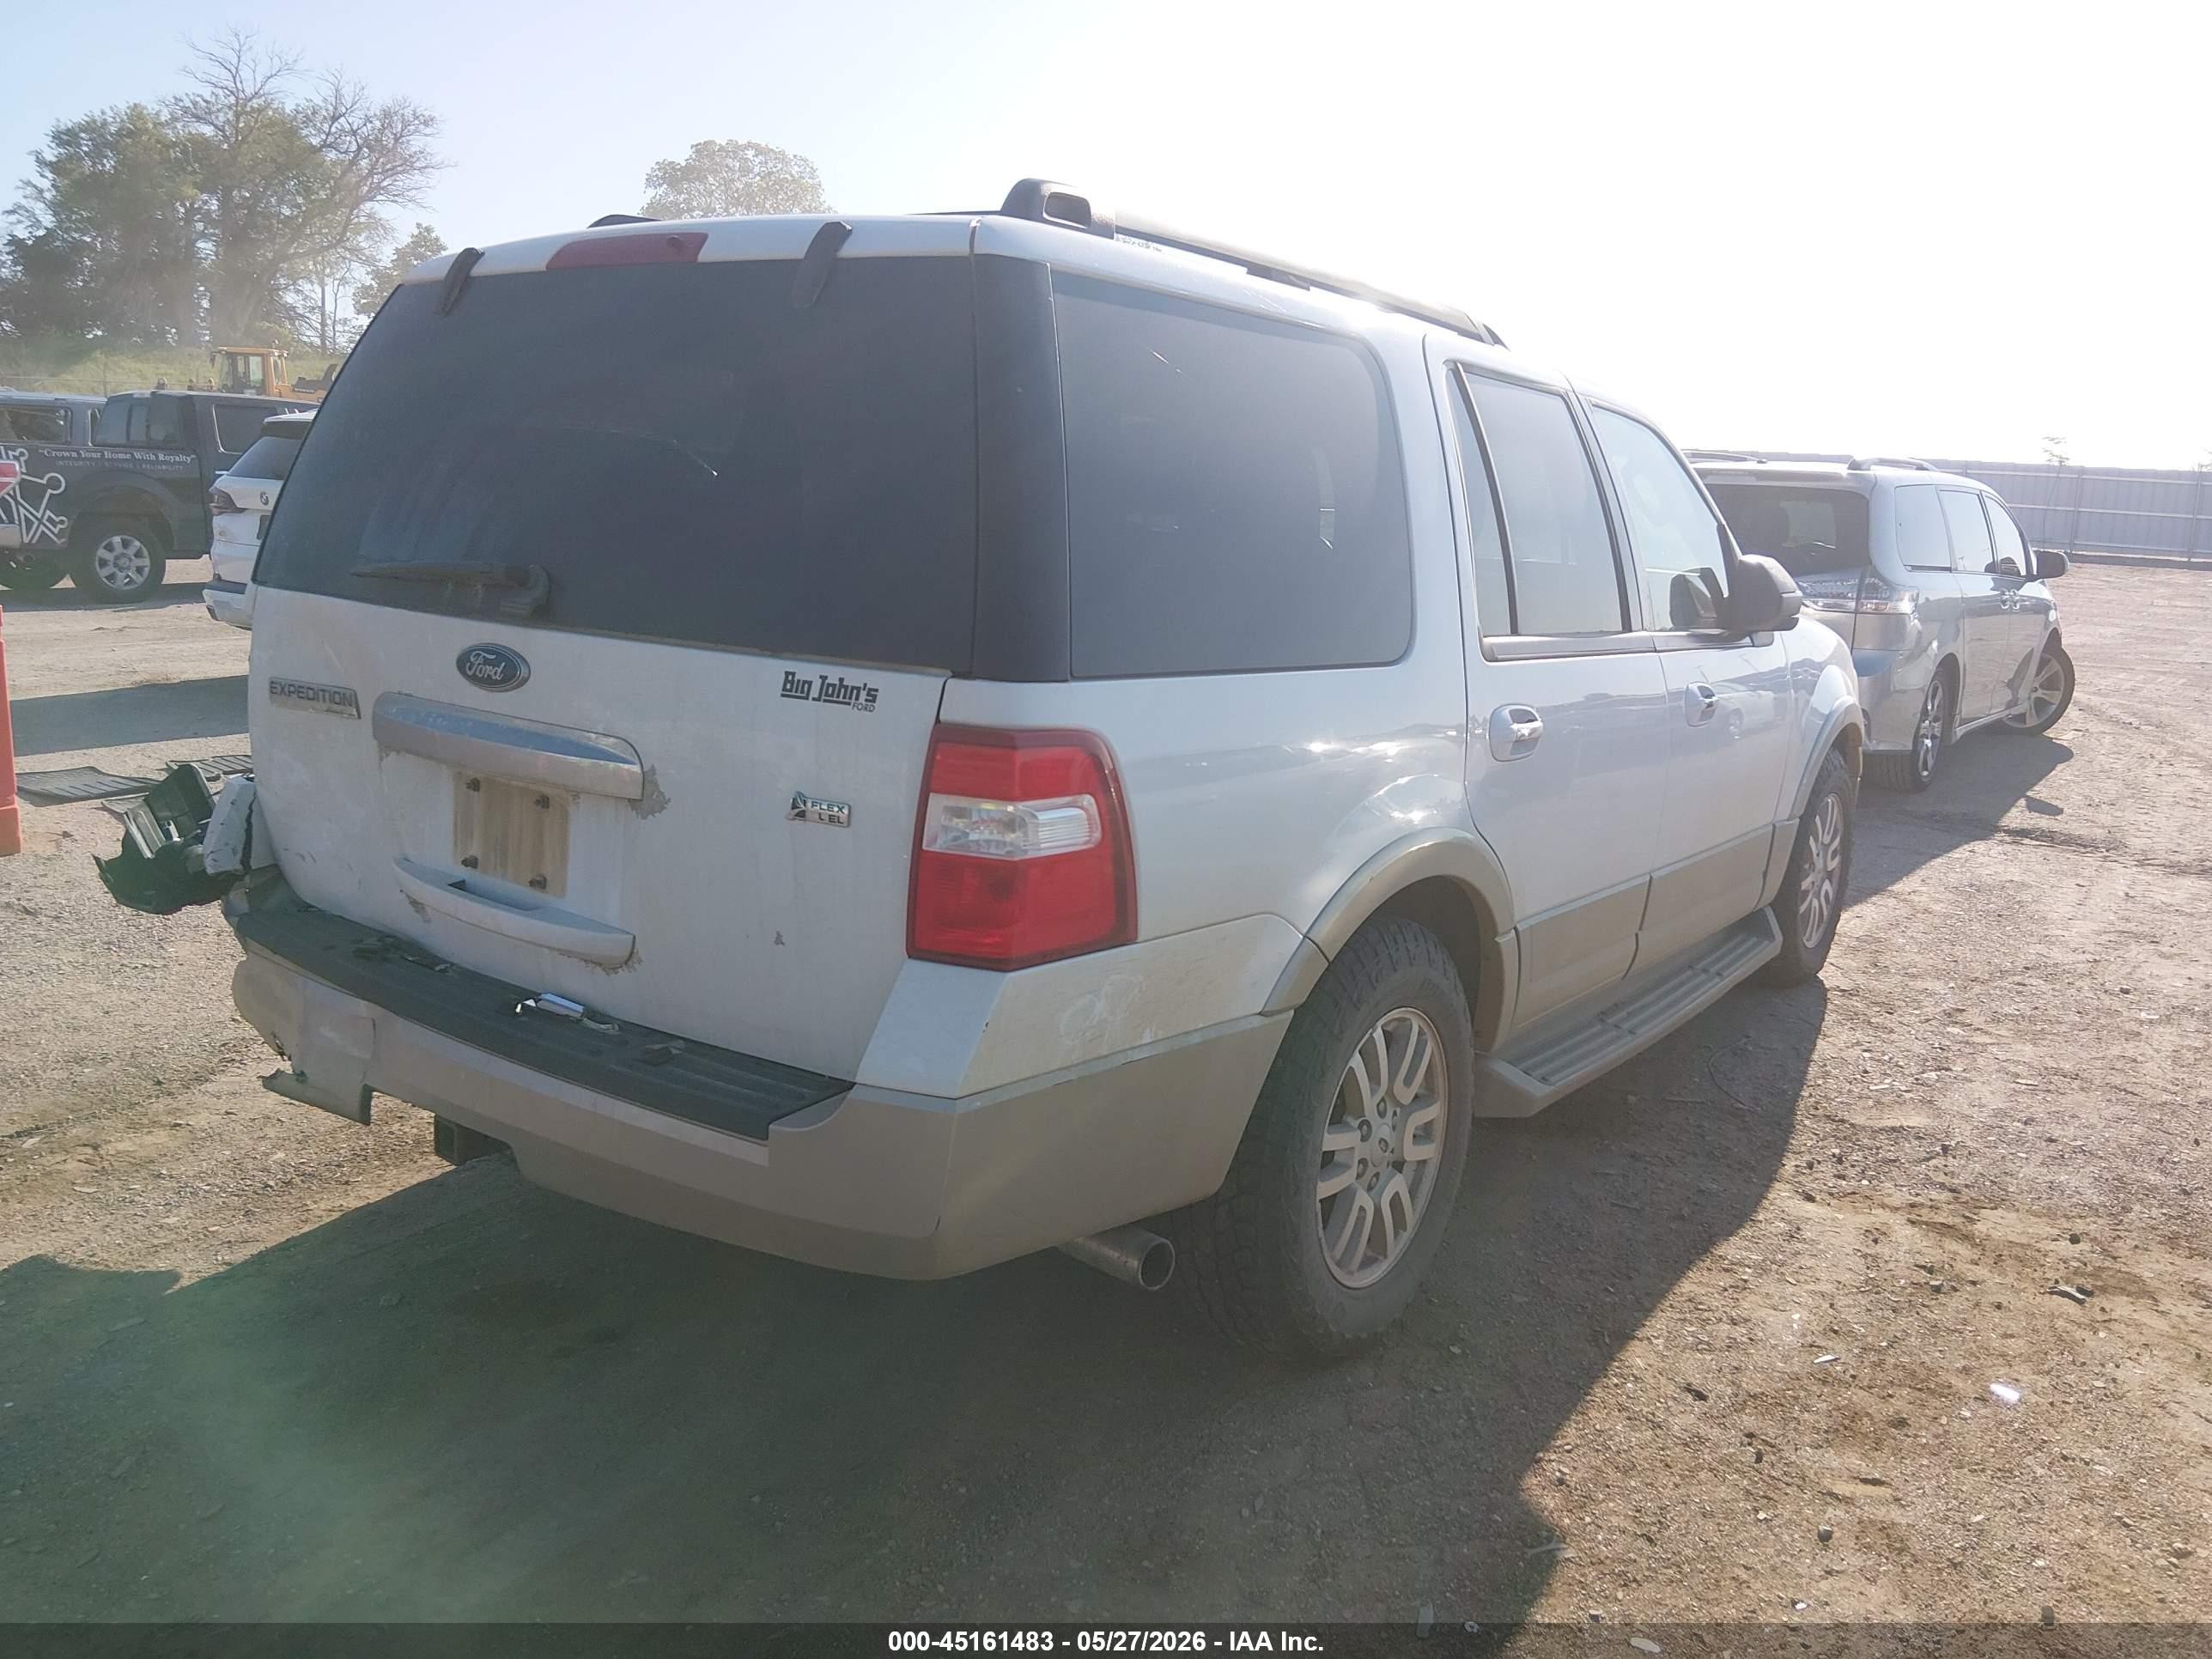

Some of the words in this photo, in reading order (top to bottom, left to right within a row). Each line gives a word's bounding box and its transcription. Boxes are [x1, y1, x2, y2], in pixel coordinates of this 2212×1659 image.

[81, 449, 101, 459] Your
[105, 451, 131, 459] Home
[133, 452, 156, 461] With
[466, 650, 506, 682] Ford
[270, 680, 355, 708] EXPEDITION
[781, 671, 813, 700] Big
[811, 675, 879, 706] John's
[852, 702, 876, 713] FORD
[811, 801, 845, 815] FLEX
